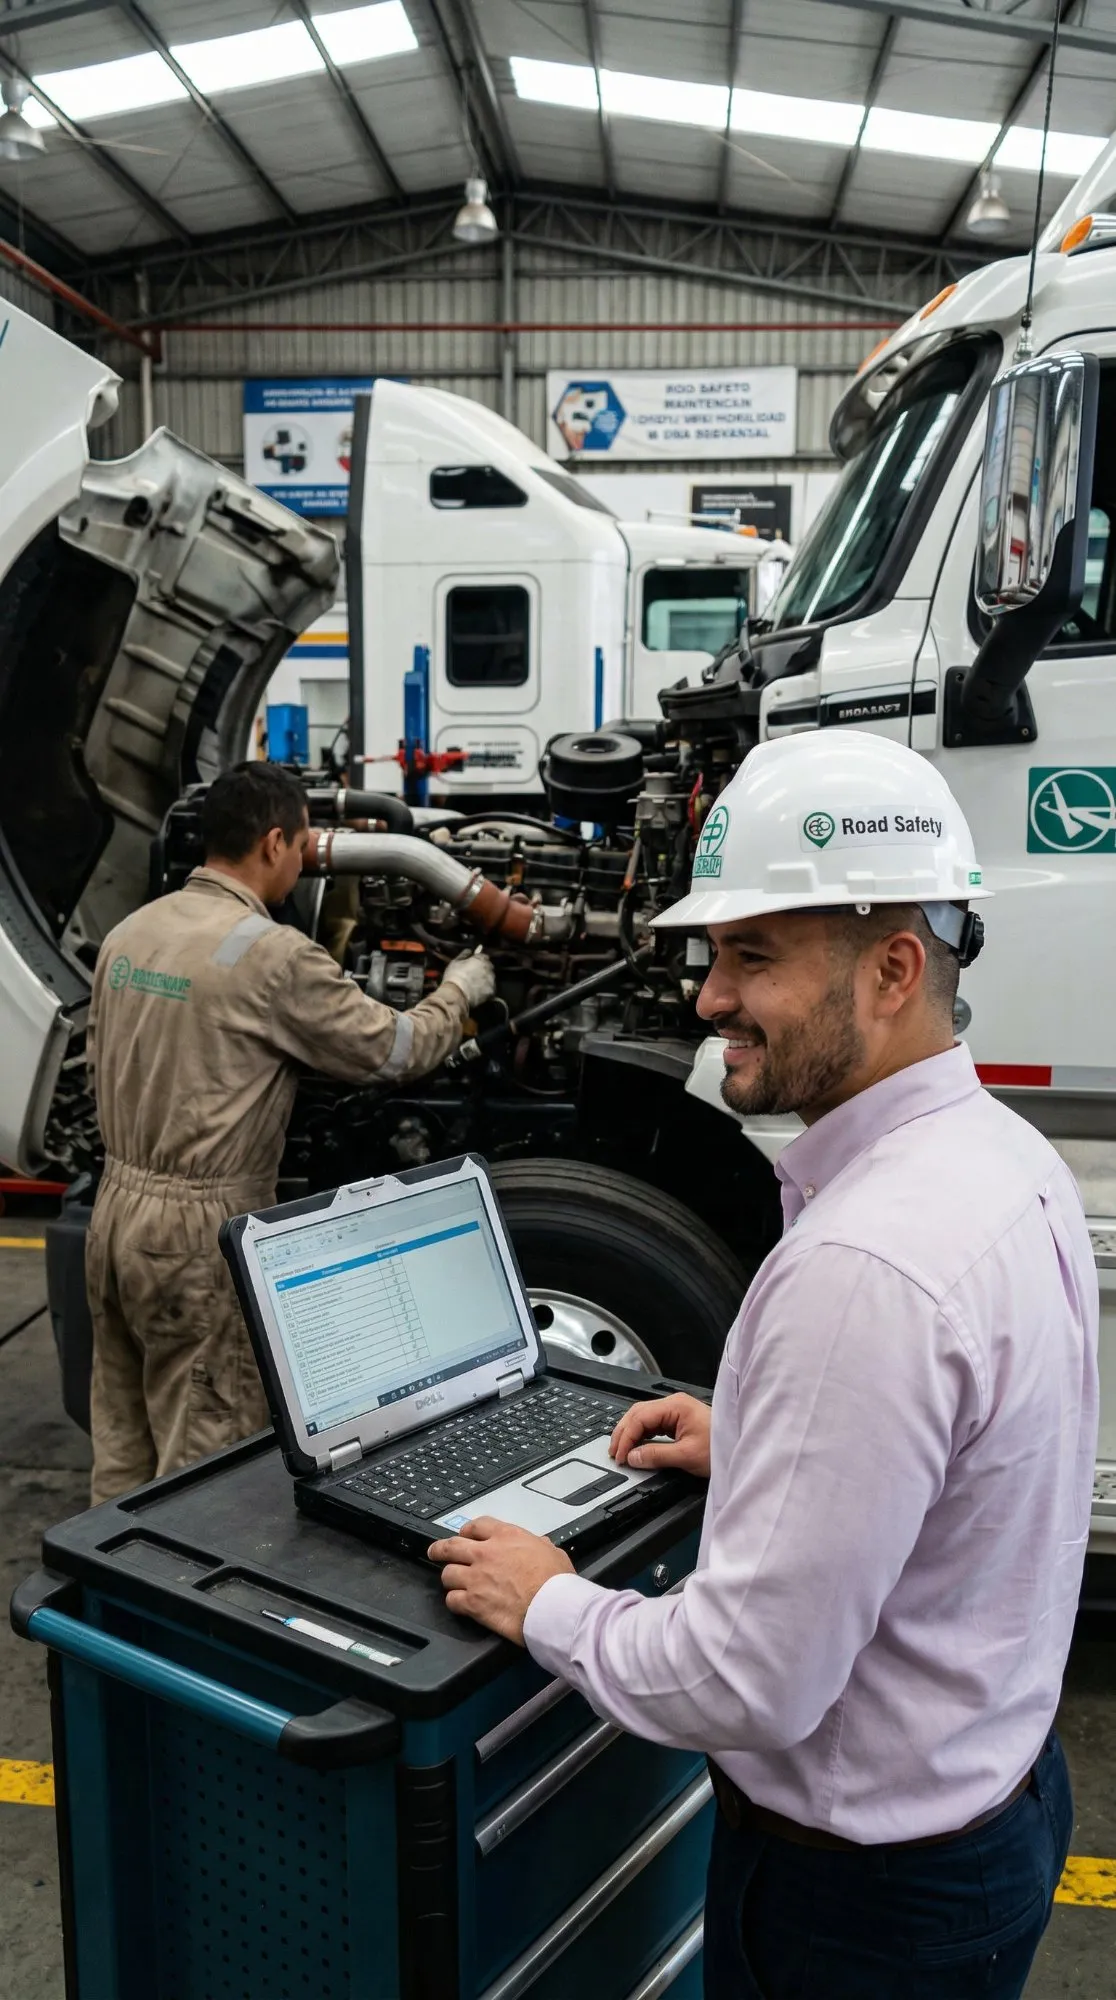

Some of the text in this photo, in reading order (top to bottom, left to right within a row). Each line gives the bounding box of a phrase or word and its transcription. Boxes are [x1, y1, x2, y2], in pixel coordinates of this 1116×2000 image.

[841, 815, 942, 838] Road Safety
[415, 1390, 445, 1410] DELL
